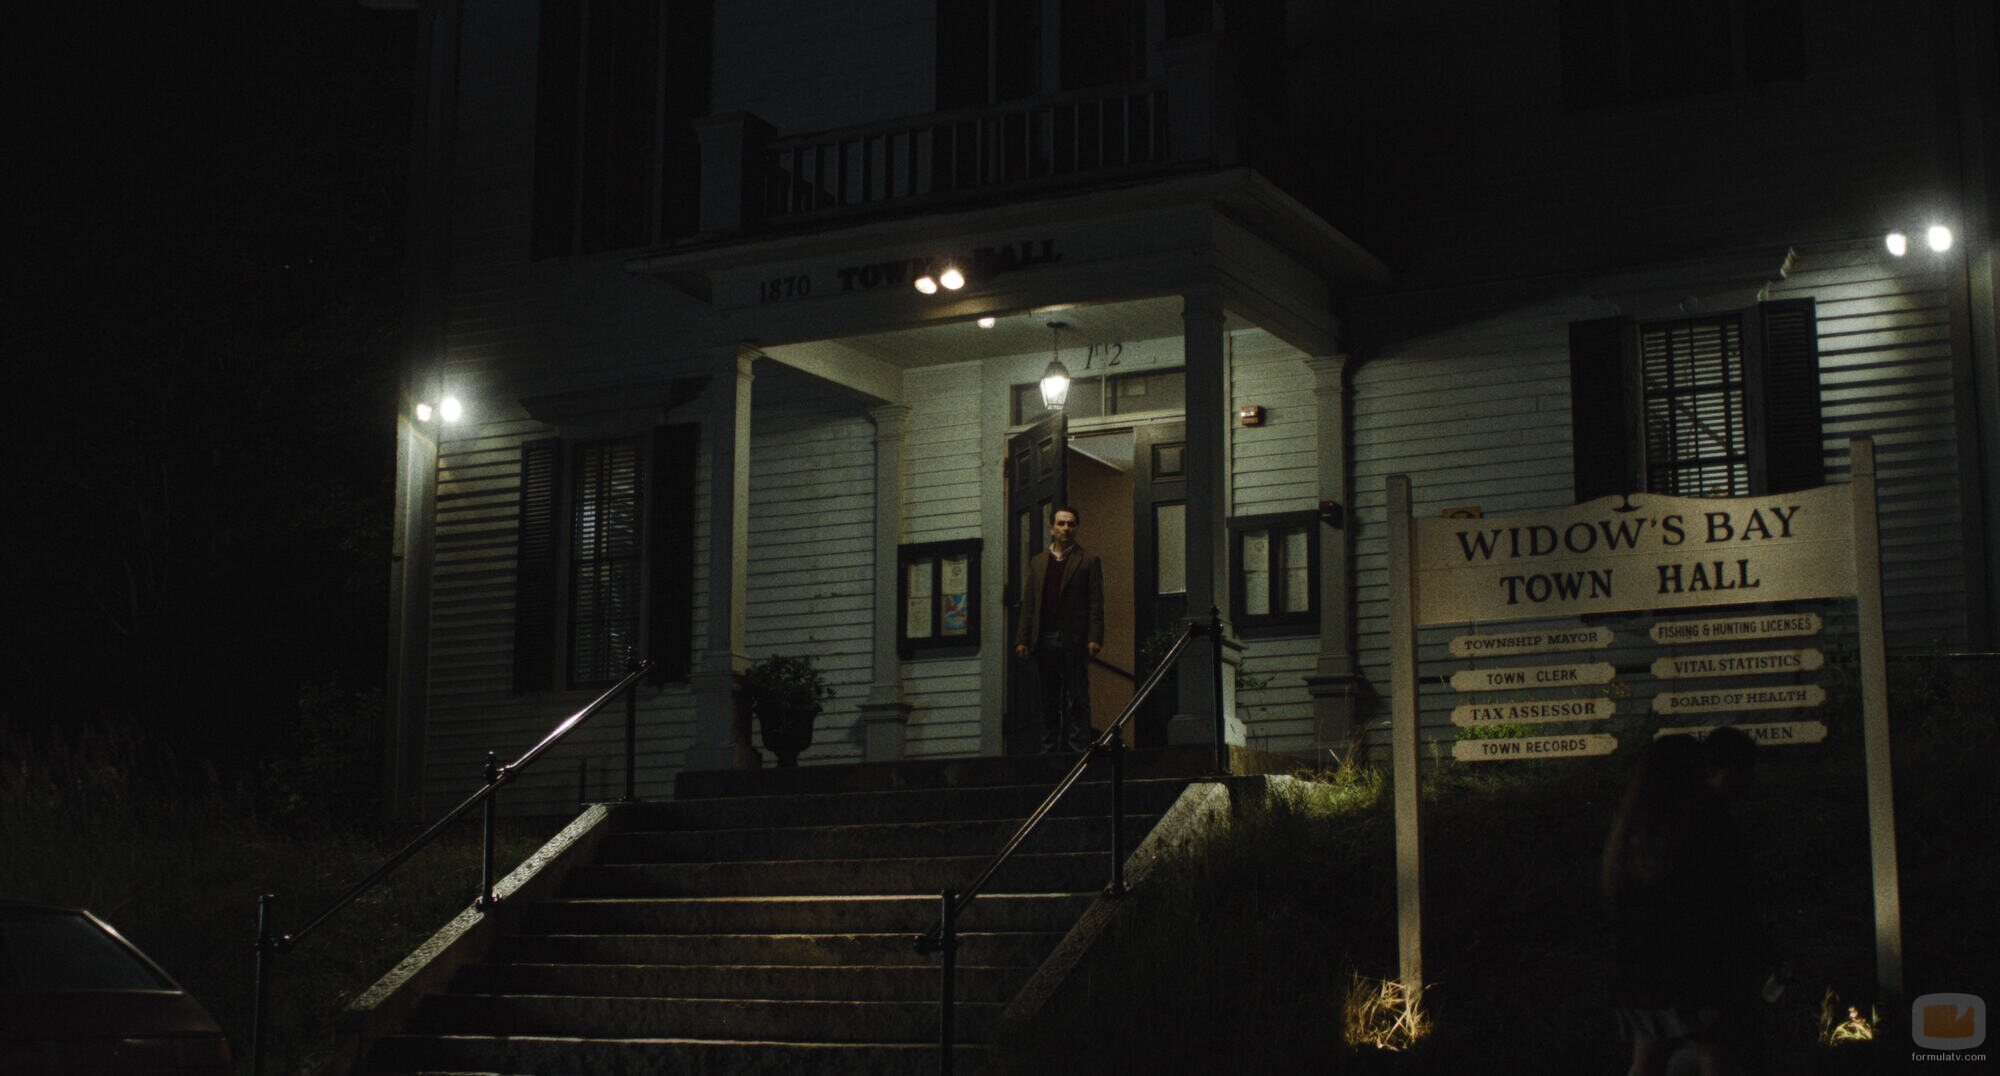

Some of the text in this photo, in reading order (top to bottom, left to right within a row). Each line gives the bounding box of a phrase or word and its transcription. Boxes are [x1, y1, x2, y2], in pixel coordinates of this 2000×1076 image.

[760, 274, 810, 302] 1870
[1456, 506, 1801, 562] WIDOW'S BAY
[1500, 559, 1760, 605] TOWN HALL
[1659, 618, 1812, 639] FISHING & HUNTING LICENSES
[1464, 632, 1598, 650] TOWNSHIP MAYOR
[1674, 654, 1801, 674] VITAL STATISTICS
[1486, 668, 1578, 686] TOWN CLERK
[1670, 690, 1807, 707] BOARD OF HEALTH
[1470, 702, 1596, 721] TAX ASSESSOR
[1482, 739, 1587, 755] TOWN RECORDS
